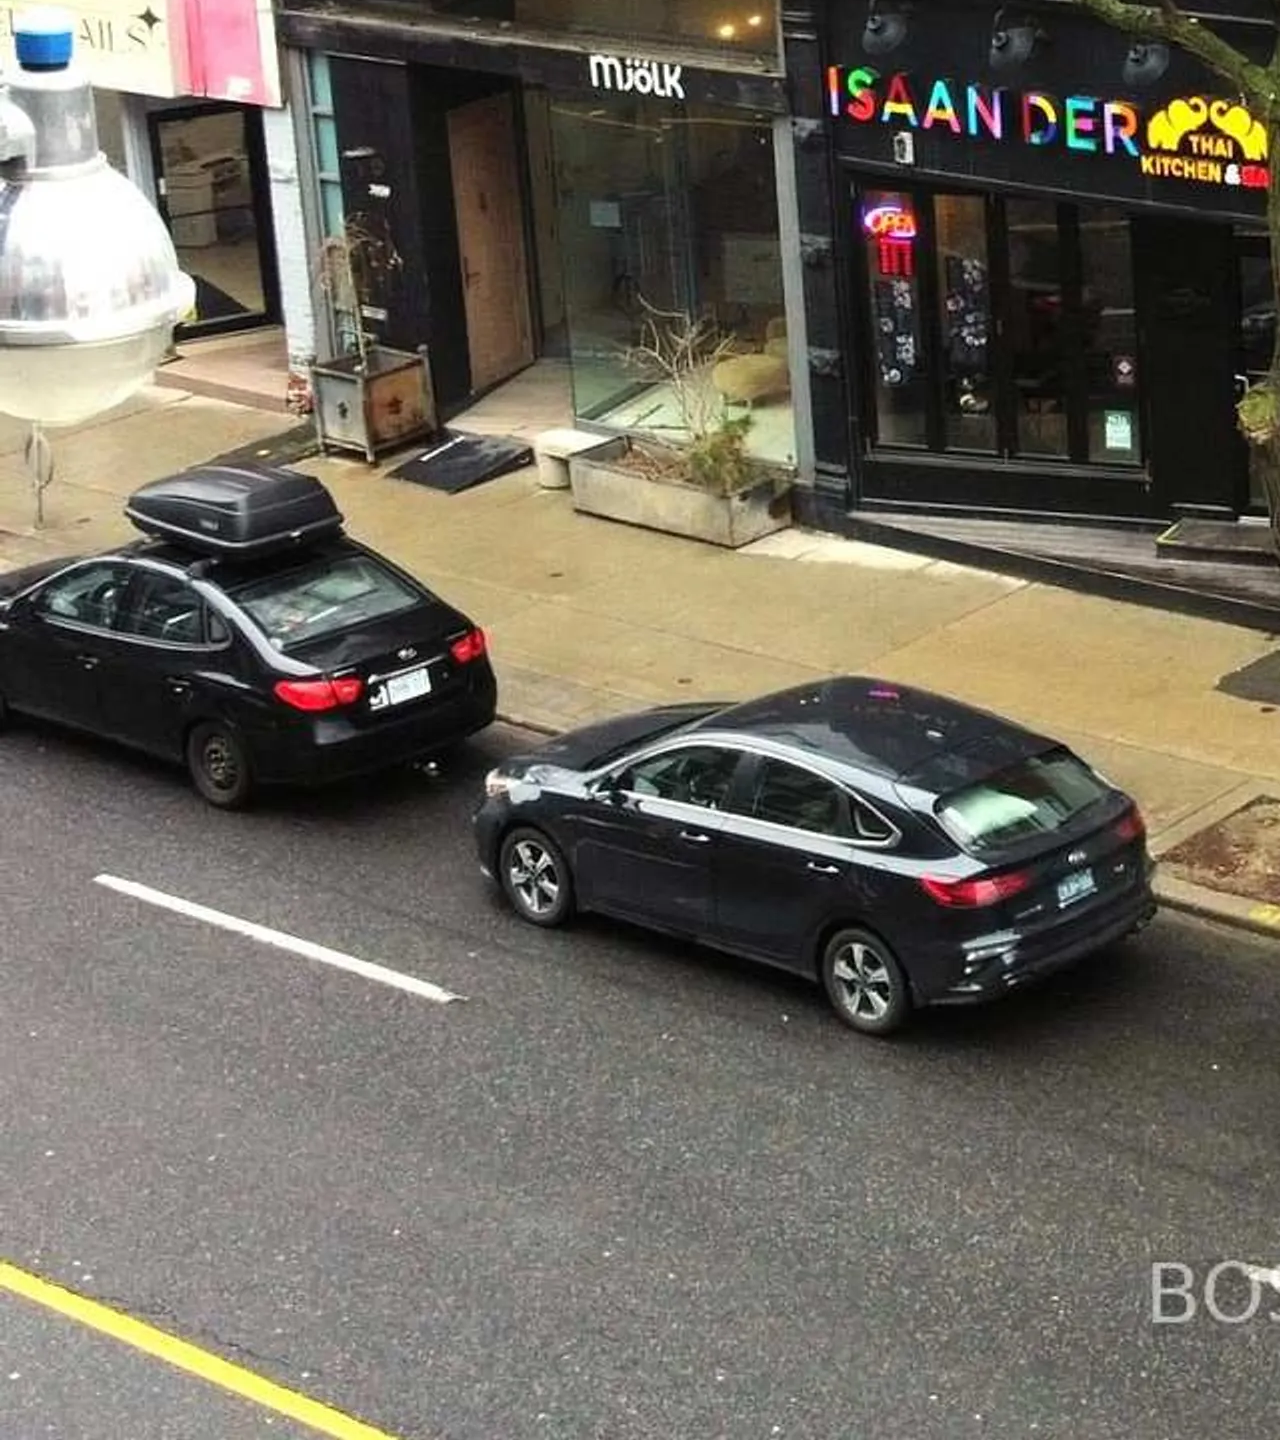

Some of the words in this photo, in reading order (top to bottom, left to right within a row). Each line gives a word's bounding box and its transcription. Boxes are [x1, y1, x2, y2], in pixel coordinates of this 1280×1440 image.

[826, 65, 1002, 141] ISAAN
[1022, 95, 1140, 157] DER
[1188, 134, 1234, 159] THAI
[1141, 155, 1222, 184] KITCHEN
[1224, 163, 1241, 185] &
